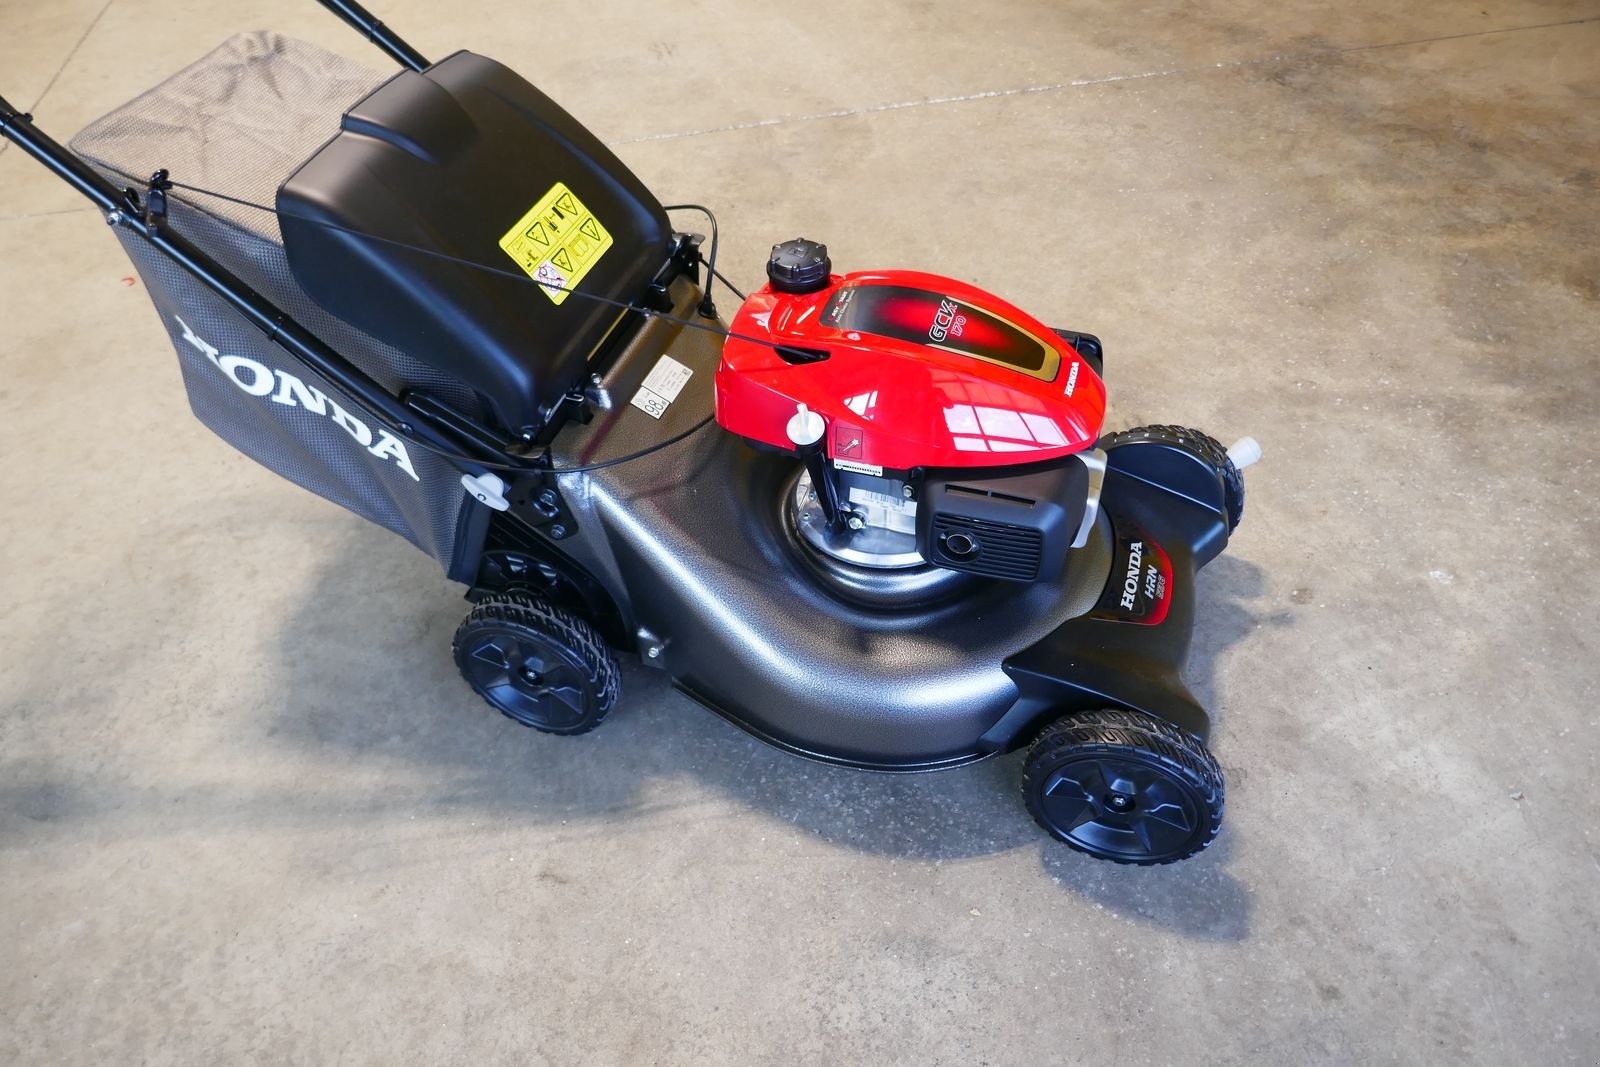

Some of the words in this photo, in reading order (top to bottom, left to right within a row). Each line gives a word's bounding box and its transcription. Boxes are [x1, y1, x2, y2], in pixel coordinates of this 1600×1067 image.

[951, 316, 966, 337] 170
[1064, 361, 1080, 398] HONDA
[644, 399, 664, 416] 98
[1120, 541, 1143, 611] HONDA
[1144, 564, 1158, 600] HRN
